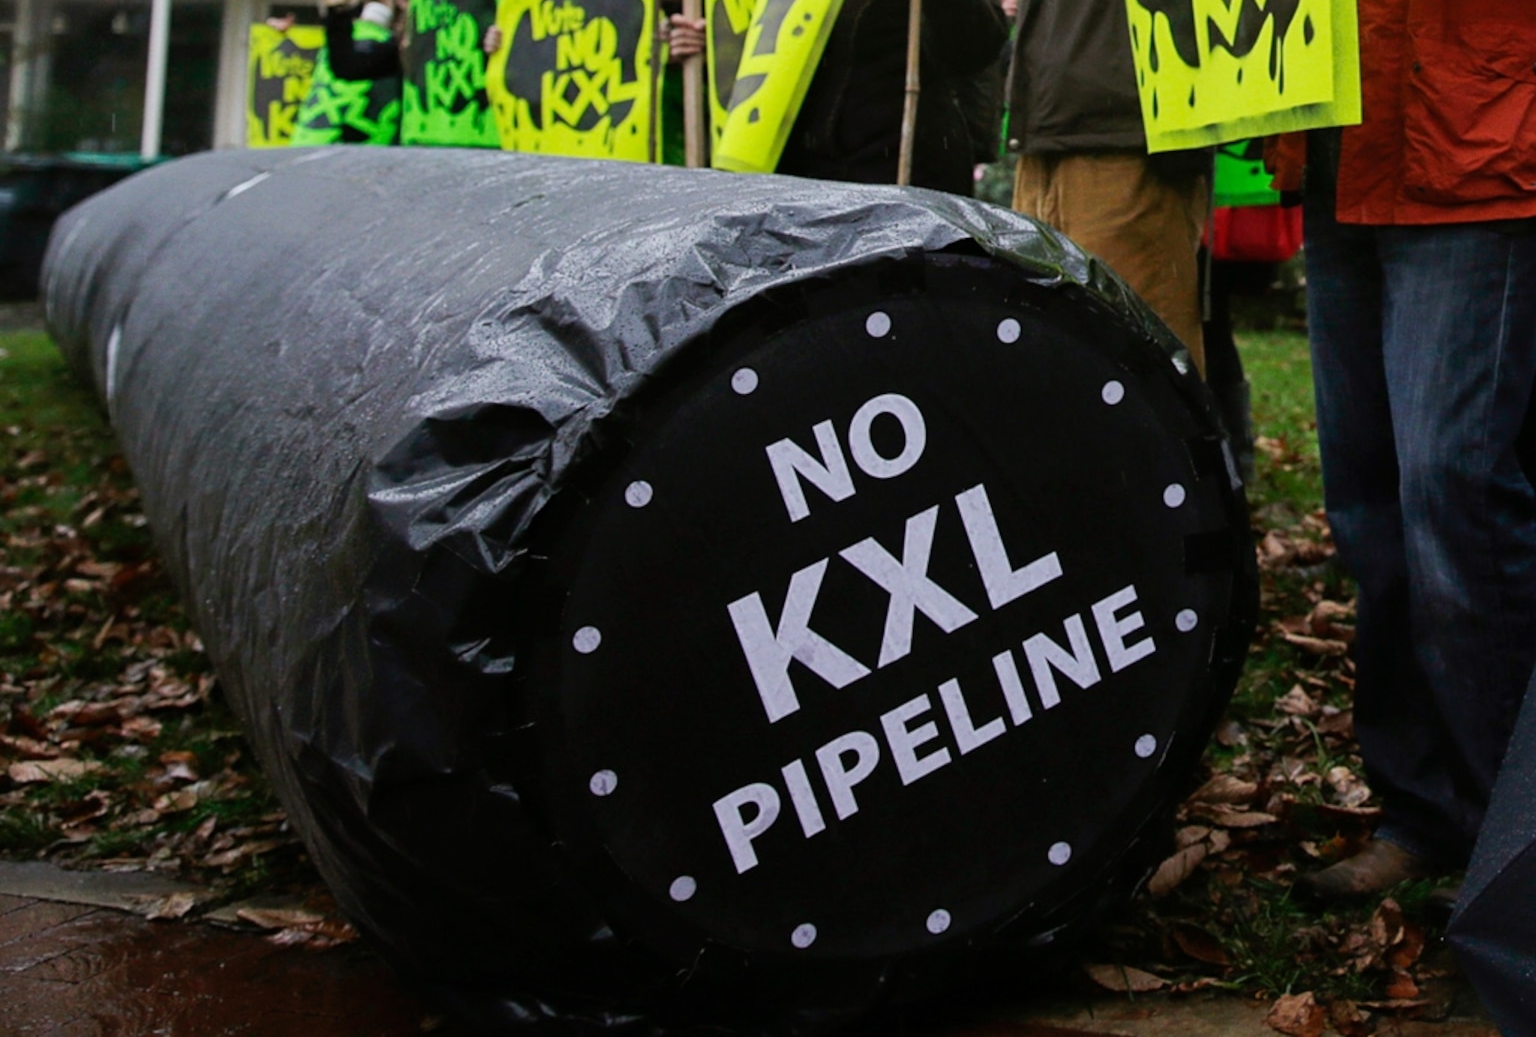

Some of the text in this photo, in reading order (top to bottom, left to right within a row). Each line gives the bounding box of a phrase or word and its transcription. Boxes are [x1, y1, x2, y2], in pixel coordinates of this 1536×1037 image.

[436, 13, 478, 60] NO
[530, 0, 586, 41] Vote
[557, 17, 617, 72] NO
[426, 49, 487, 110] KXL
[541, 57, 641, 128] KXL
[765, 394, 926, 522] NO
[727, 483, 1063, 724] KXL
[712, 584, 1156, 874] PIPELINE
